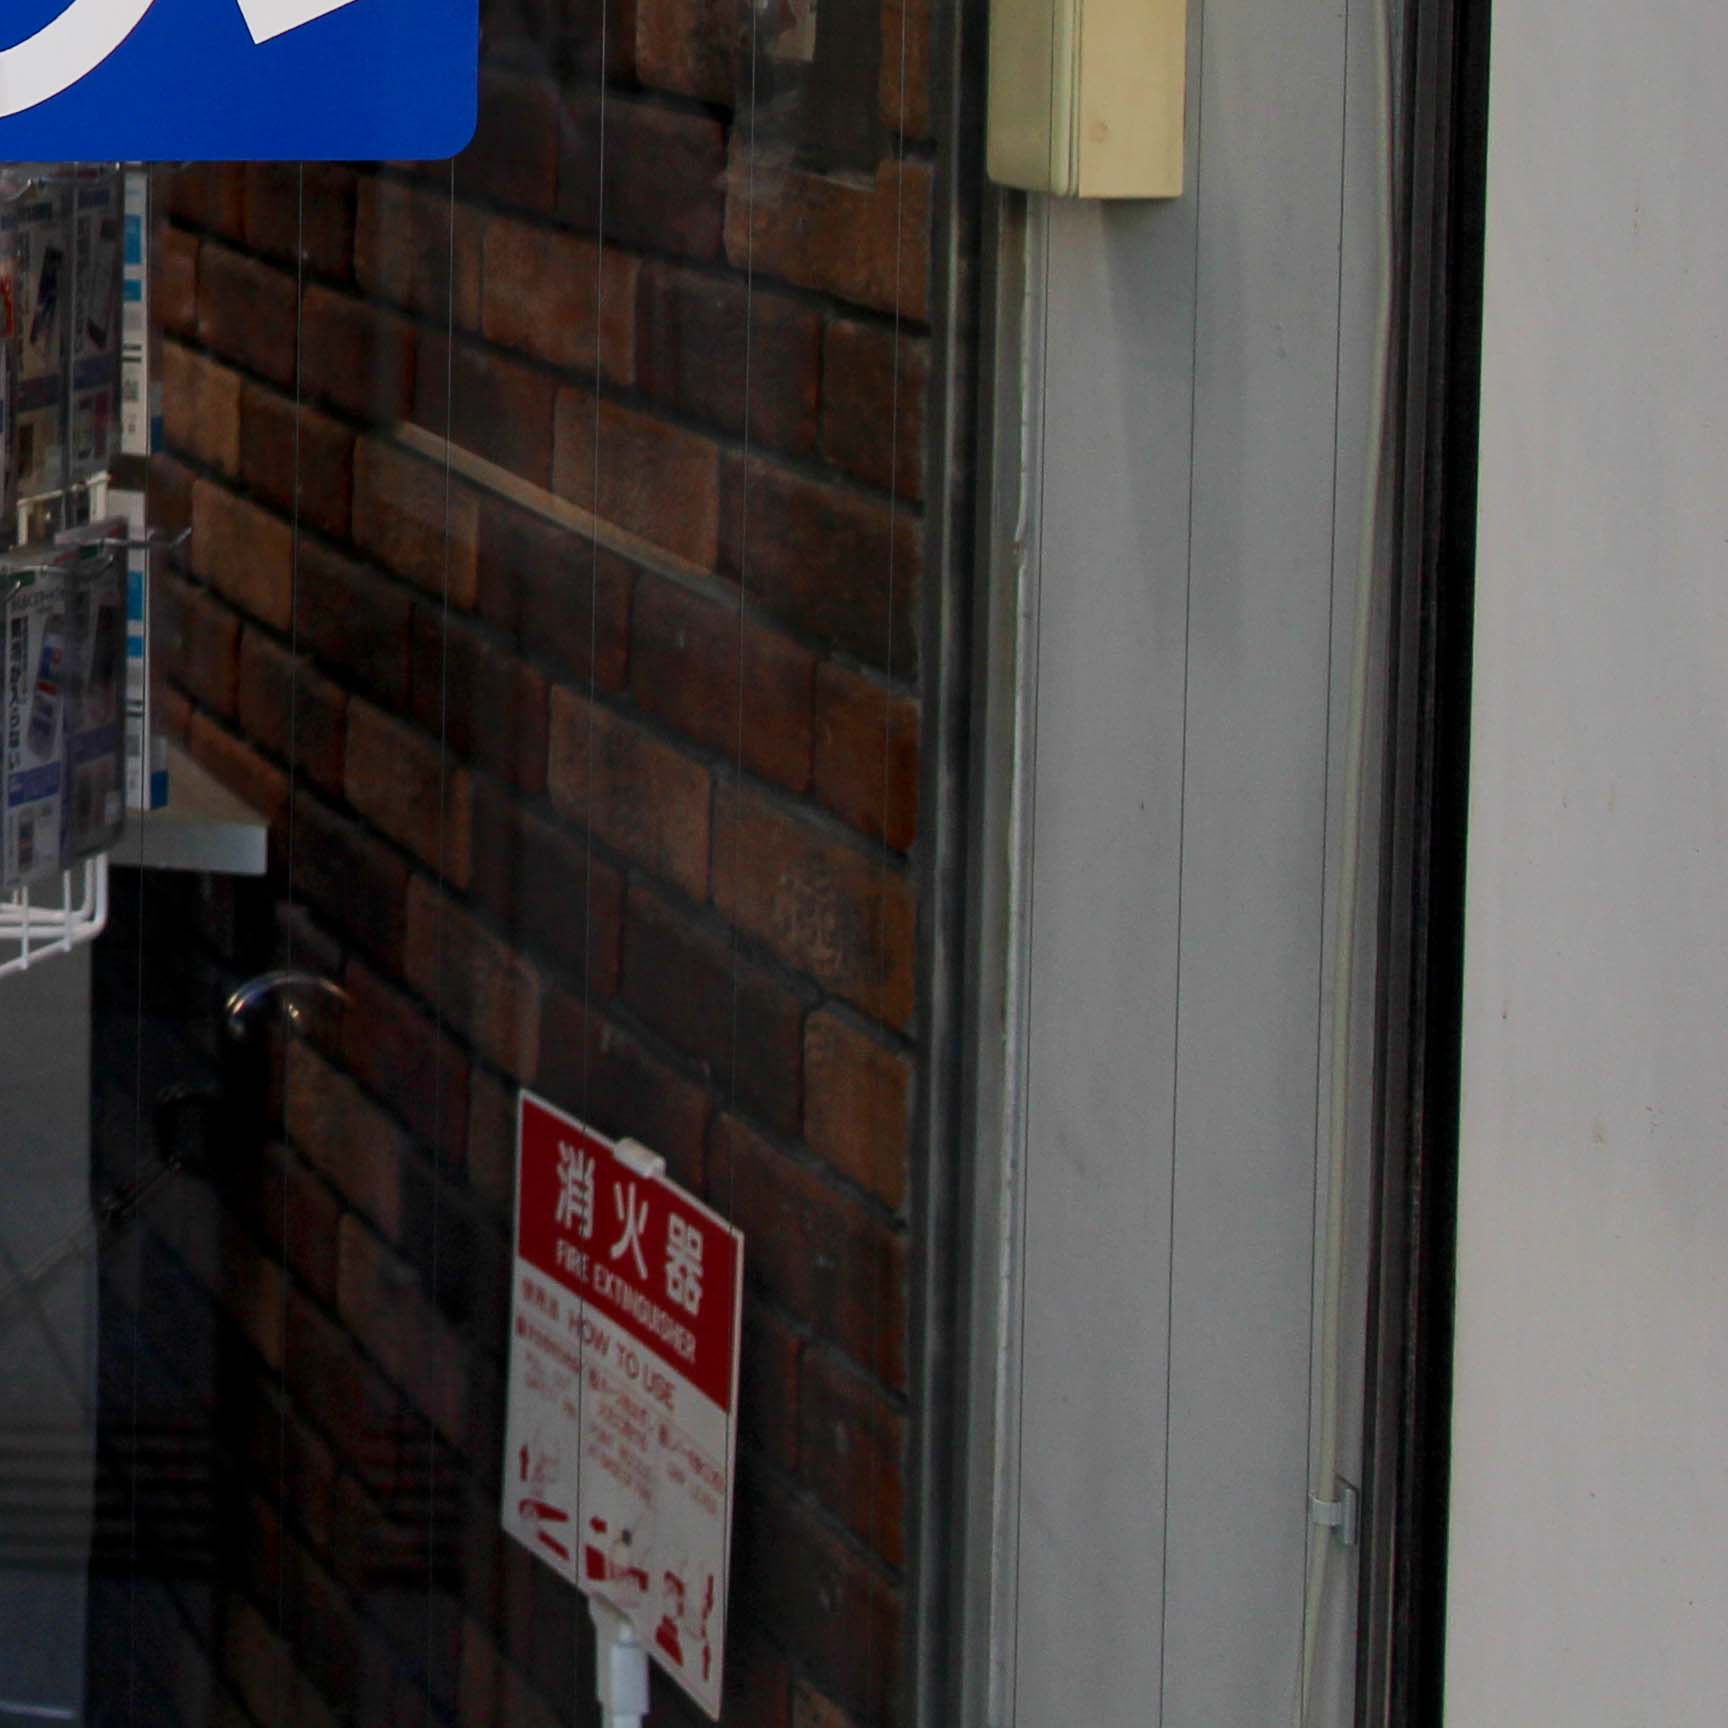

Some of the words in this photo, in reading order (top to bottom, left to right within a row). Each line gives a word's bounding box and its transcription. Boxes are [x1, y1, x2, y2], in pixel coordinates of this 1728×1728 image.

[556, 1139, 704, 1317] 消火器
[555, 1236, 591, 1284] FIRE
[592, 1261, 698, 1367] EXTINGUISHER
[568, 1312, 610, 1356] HOW
[617, 1341, 640, 1379] TO
